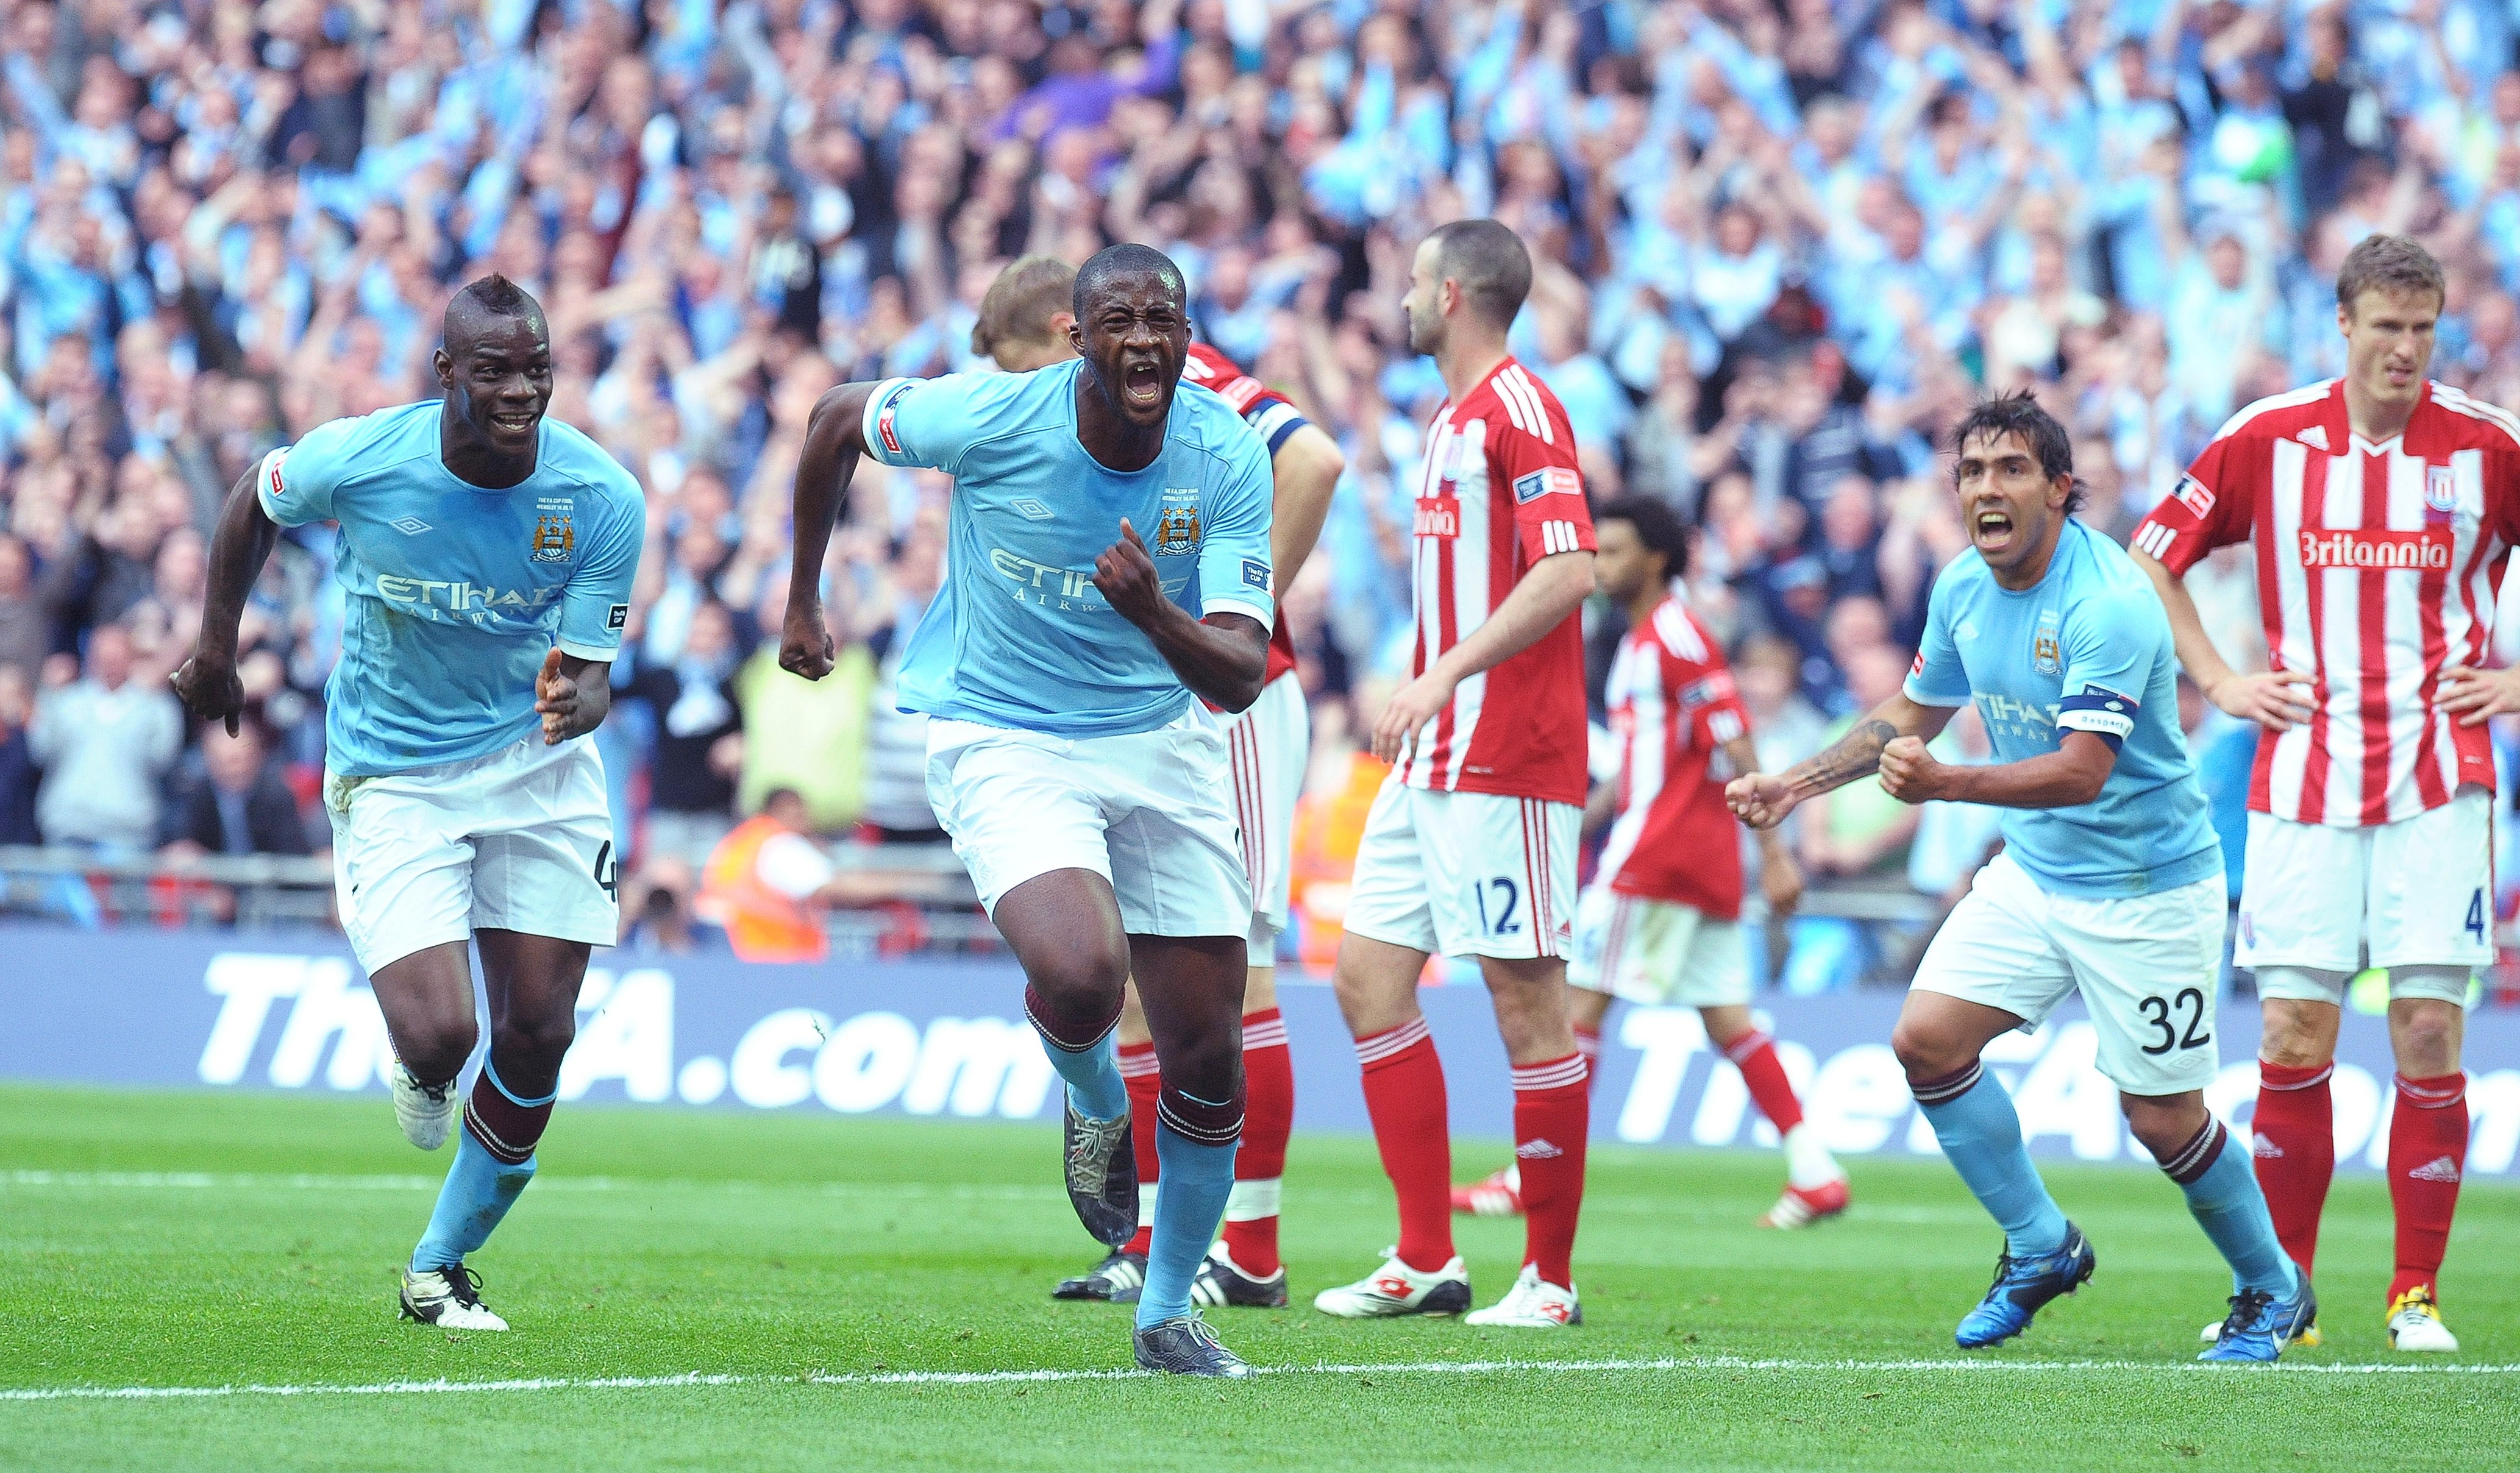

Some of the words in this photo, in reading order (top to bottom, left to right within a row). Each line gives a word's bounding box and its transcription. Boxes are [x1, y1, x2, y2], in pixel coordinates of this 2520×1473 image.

[2301, 531, 2448, 568] Britannia
[408, 608, 516, 625] AIRWA
[1013, 587, 1097, 612] AIRW
[1475, 876, 1521, 936] 12
[2465, 887, 2484, 945] 4
[198, 951, 1053, 1119] ThA.com
[2139, 988, 2210, 1056] 32
